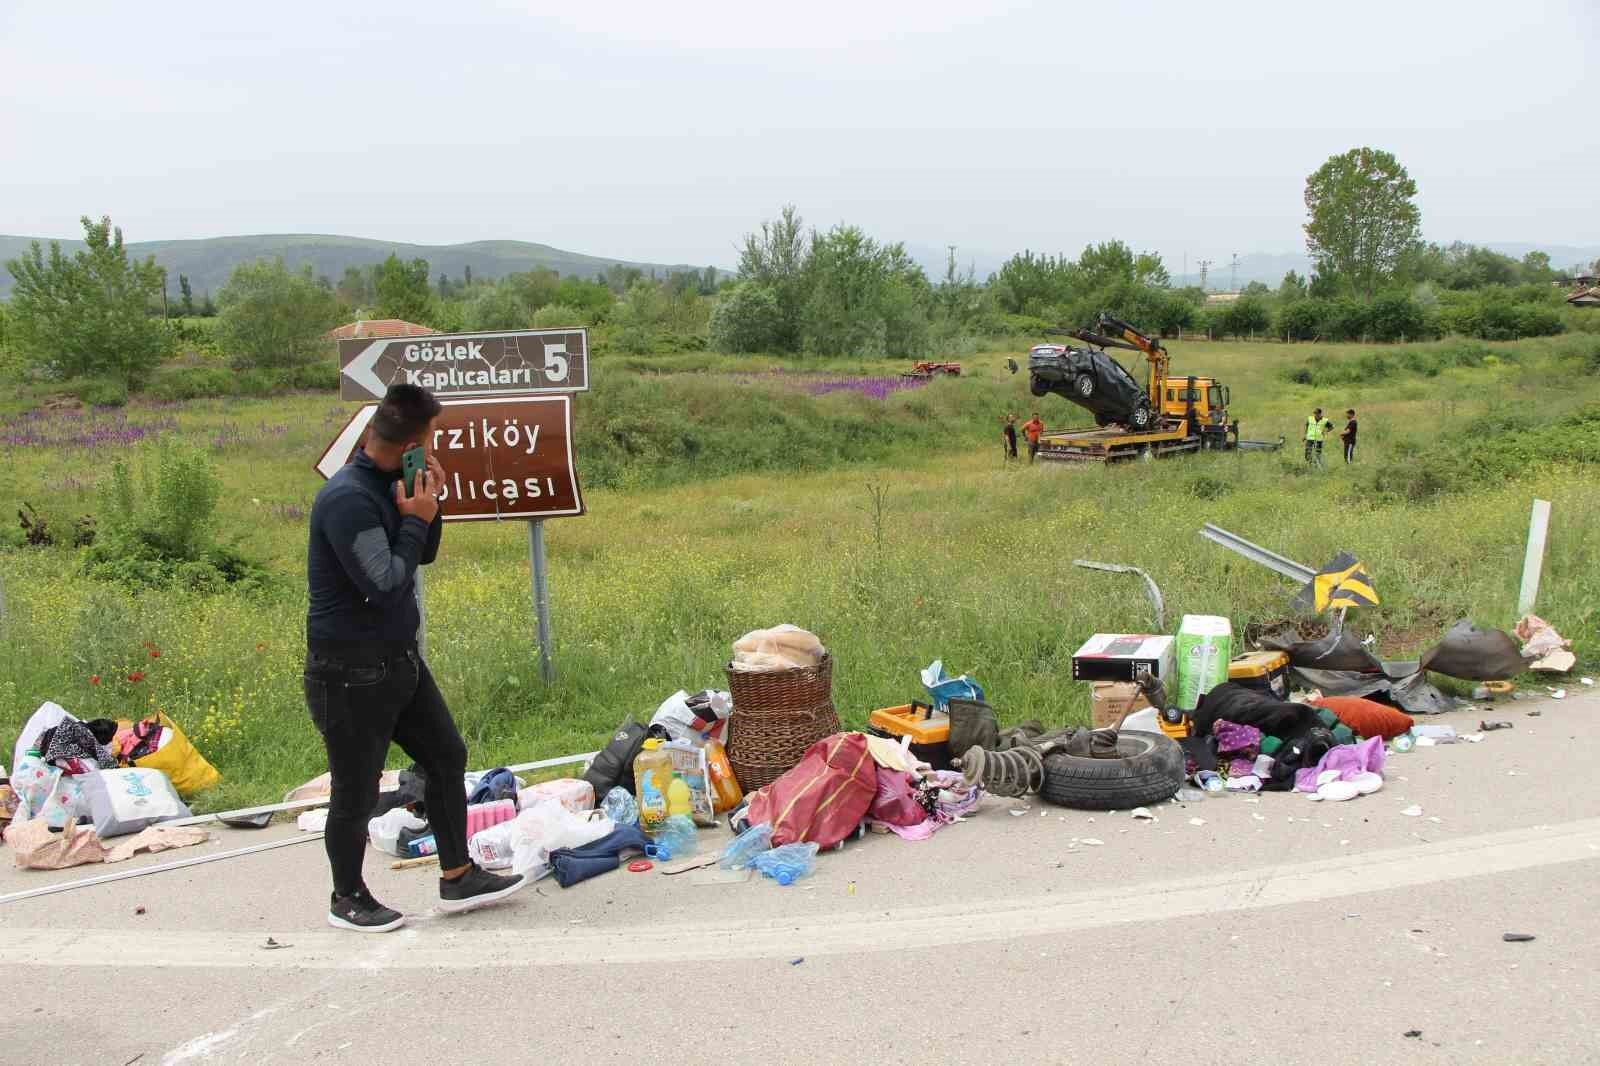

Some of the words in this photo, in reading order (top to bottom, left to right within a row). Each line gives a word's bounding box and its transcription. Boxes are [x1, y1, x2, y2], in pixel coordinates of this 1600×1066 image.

[405, 341, 484, 363] Gözlek
[544, 343, 568, 382] 5
[406, 366, 531, 390] Kaplıcaları
[433, 418, 540, 454] rziköy
